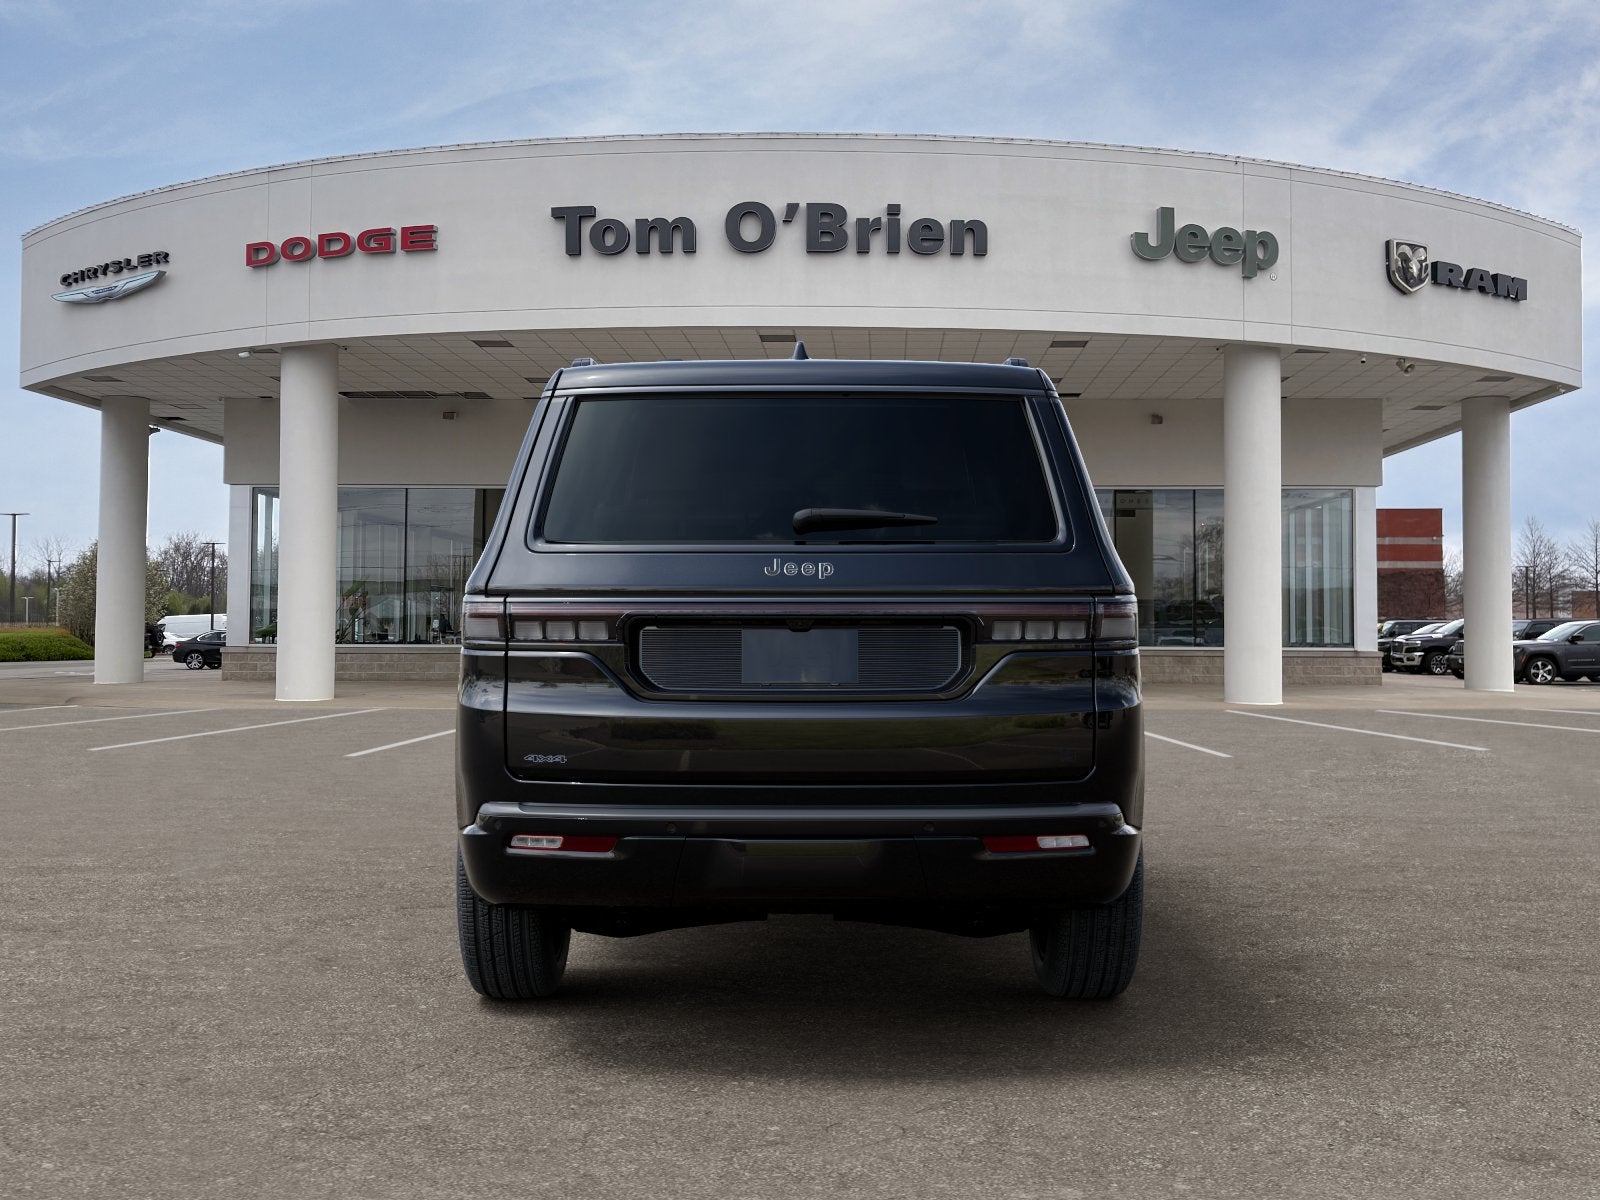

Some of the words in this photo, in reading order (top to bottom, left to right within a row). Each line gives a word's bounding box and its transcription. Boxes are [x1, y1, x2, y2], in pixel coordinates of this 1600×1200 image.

[246, 224, 438, 268] DODGE
[551, 206, 697, 256] Tom
[725, 201, 988, 257] O'Brien
[1131, 207, 1280, 278] Jeep
[60, 251, 170, 287] CHRYSLER
[1431, 261, 1528, 302] RAM
[764, 558, 835, 579] Jeep
